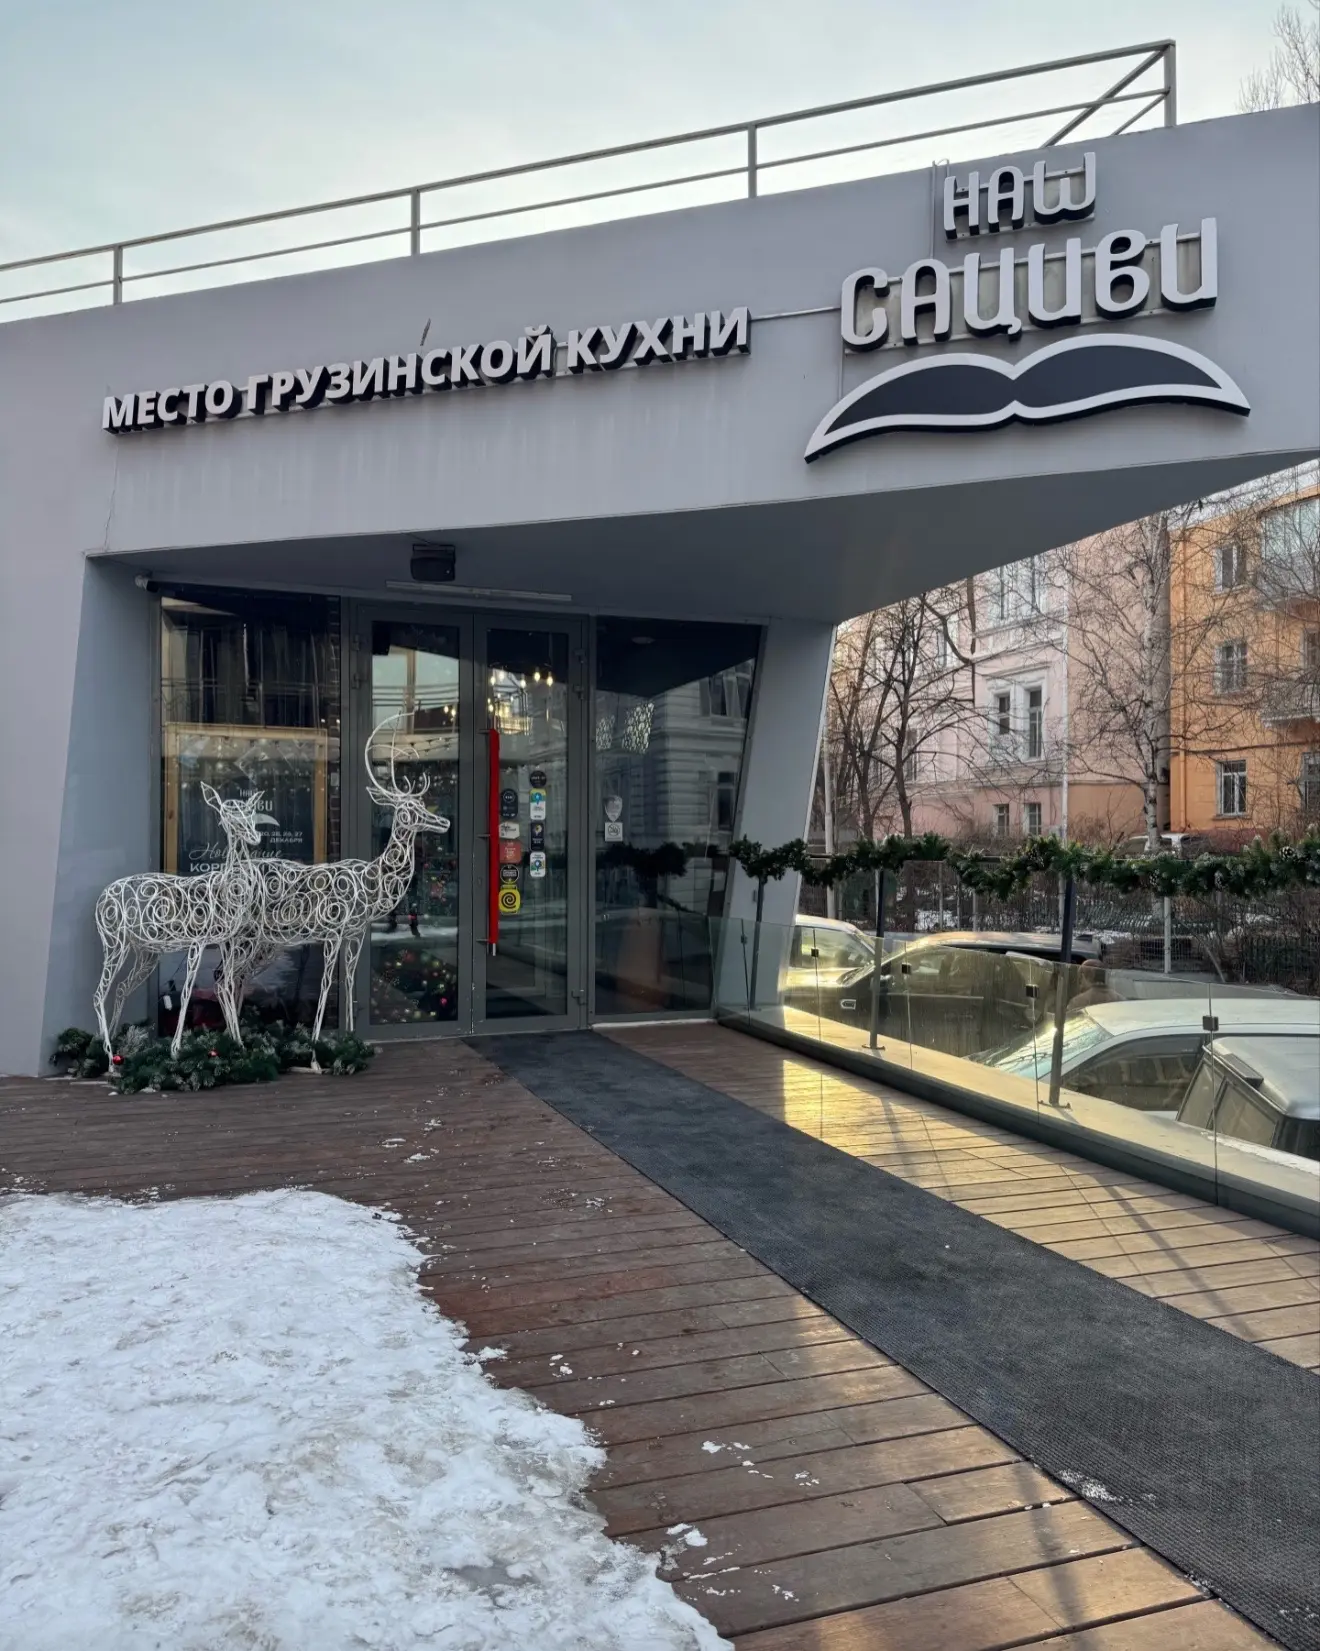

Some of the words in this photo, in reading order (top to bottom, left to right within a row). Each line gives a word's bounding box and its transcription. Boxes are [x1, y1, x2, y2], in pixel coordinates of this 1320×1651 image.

[943, 152, 1096, 238] НАШ
[840, 217, 1218, 350] САЦИВИ
[101, 378, 235, 432] МЕСТО
[246, 325, 554, 411] ГРУЗИНСКОЙ
[566, 307, 751, 374] КУХНИ
